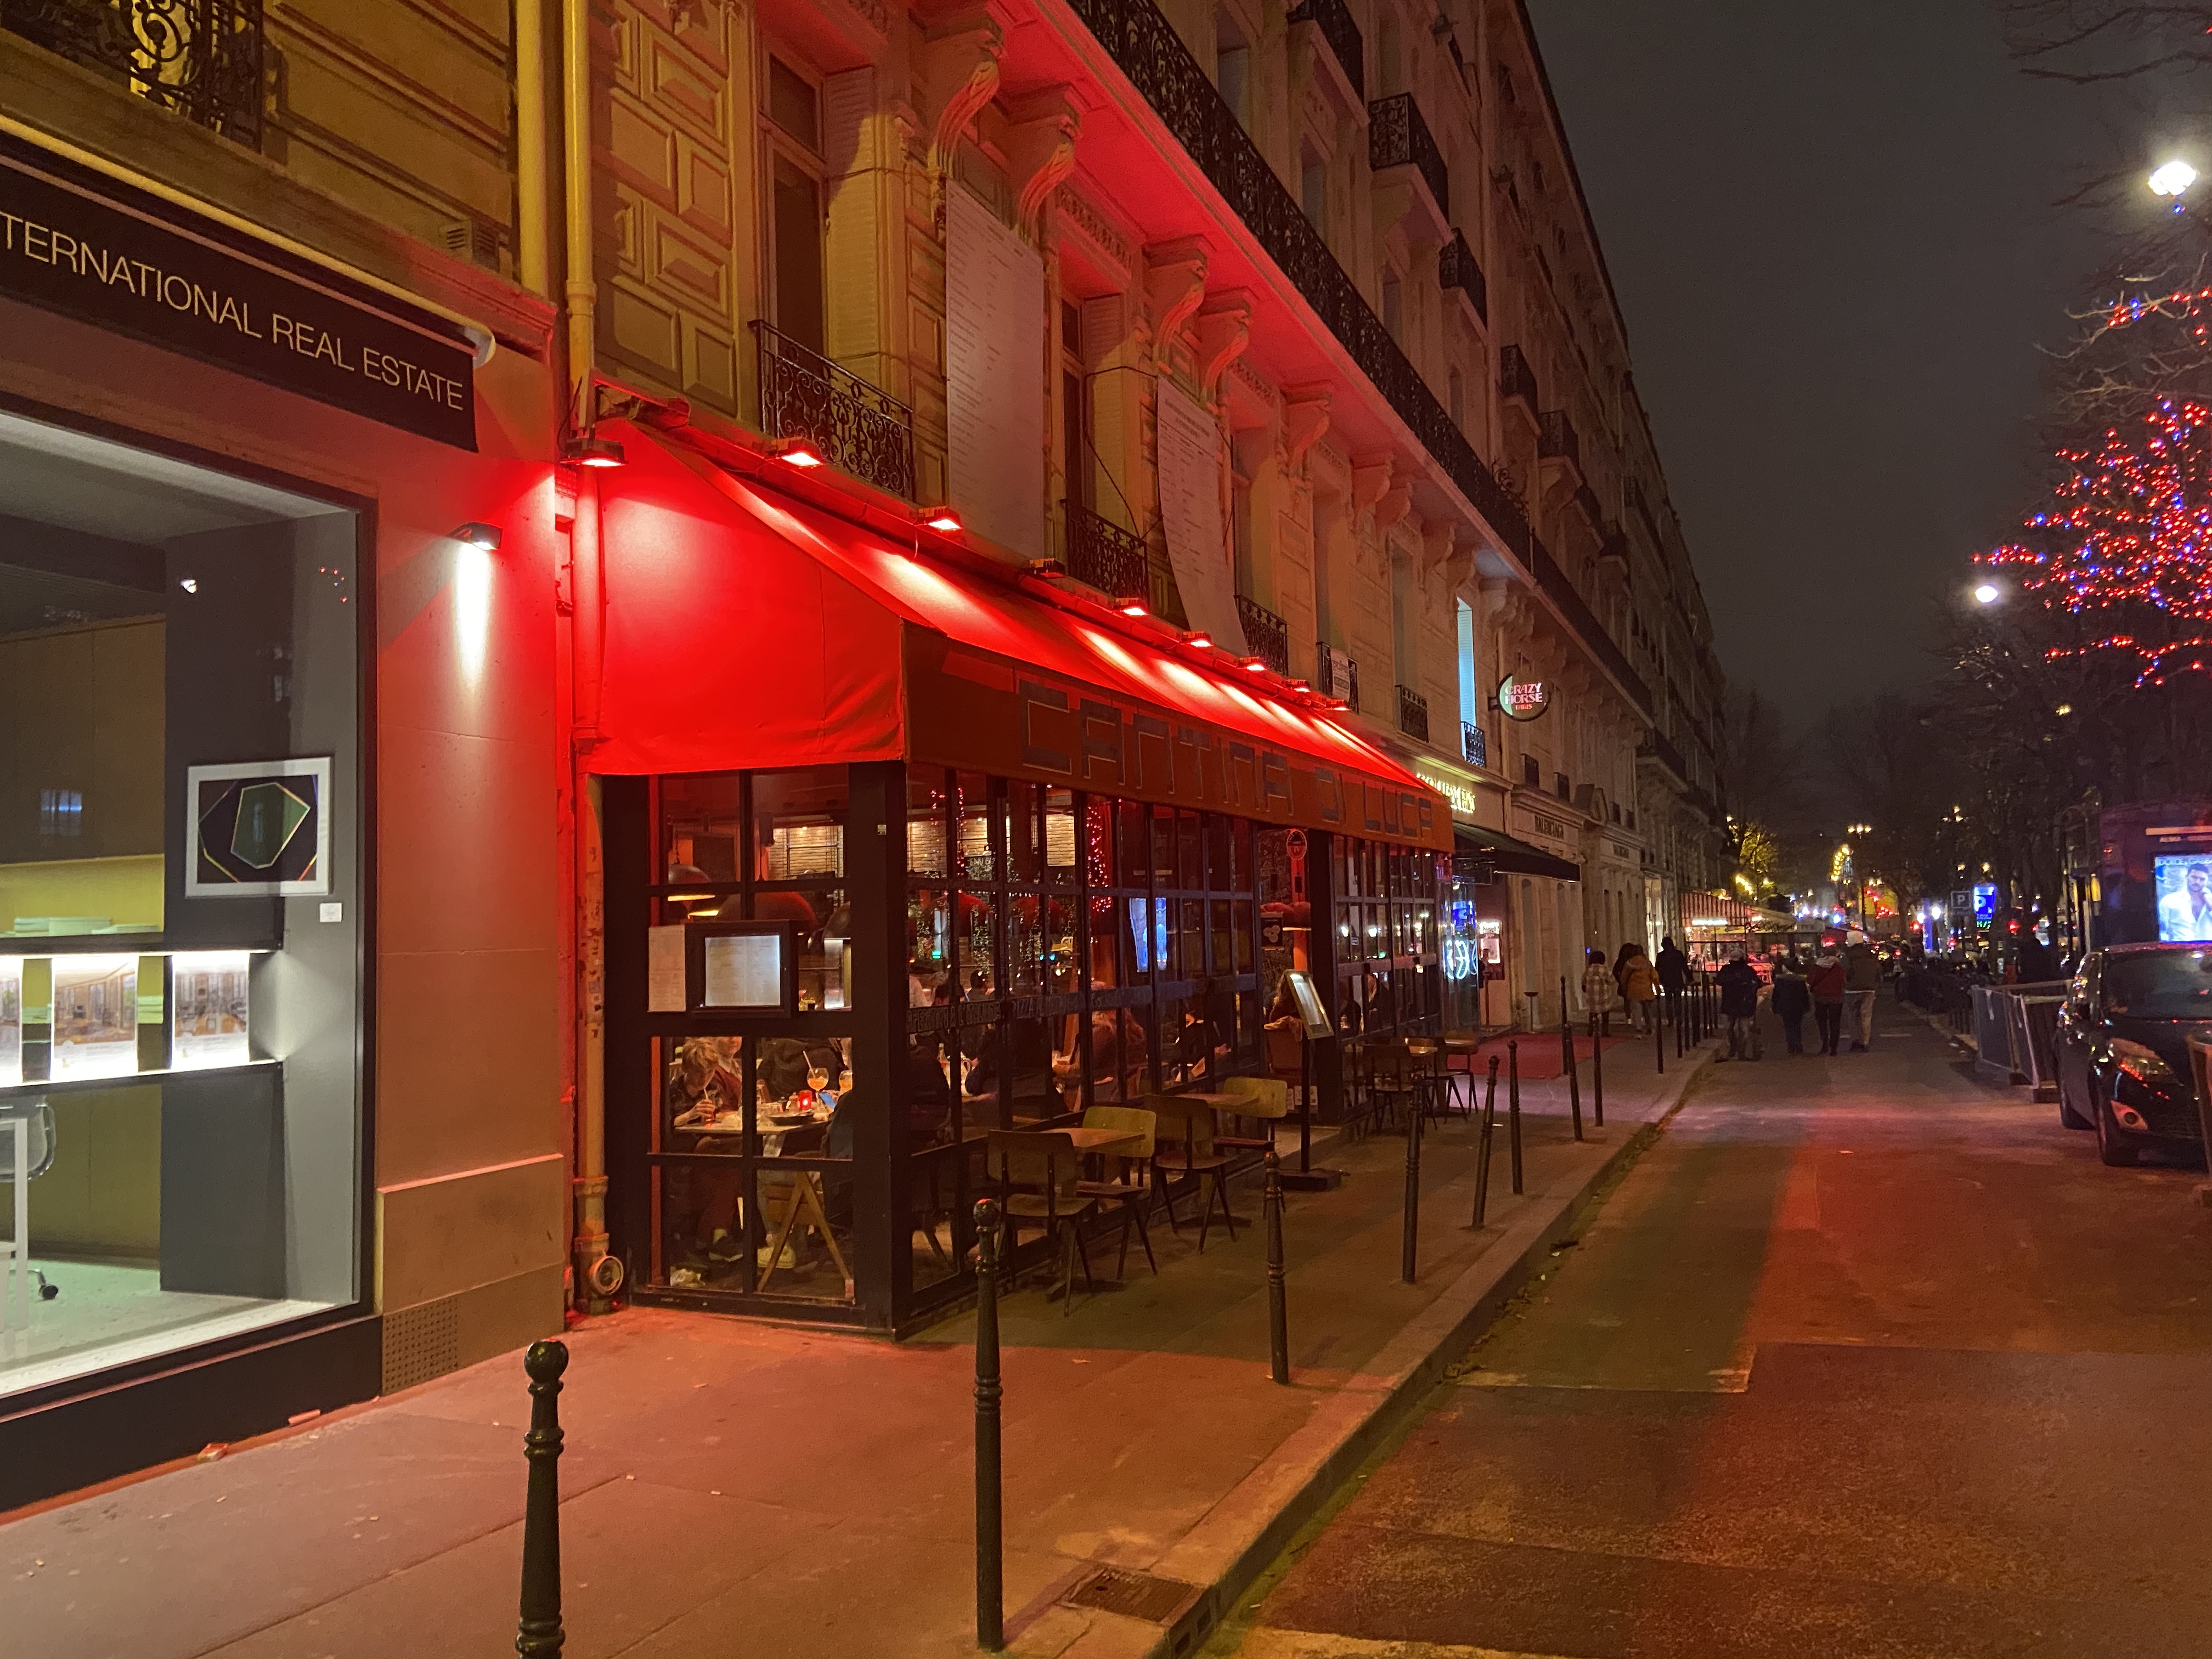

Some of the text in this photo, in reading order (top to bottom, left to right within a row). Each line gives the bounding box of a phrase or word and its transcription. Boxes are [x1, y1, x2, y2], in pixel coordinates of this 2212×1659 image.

[273, 314, 354, 372] REAL
[364, 347, 463, 411] ESTATE
[1505, 681, 1542, 695] CRAZY
[1505, 692, 1543, 704] HORSE
[1019, 679, 1293, 816] CANTINA
[1362, 781, 1433, 840] LUCA
[1957, 894, 1966, 905] P
[1974, 895, 1987, 912] P
